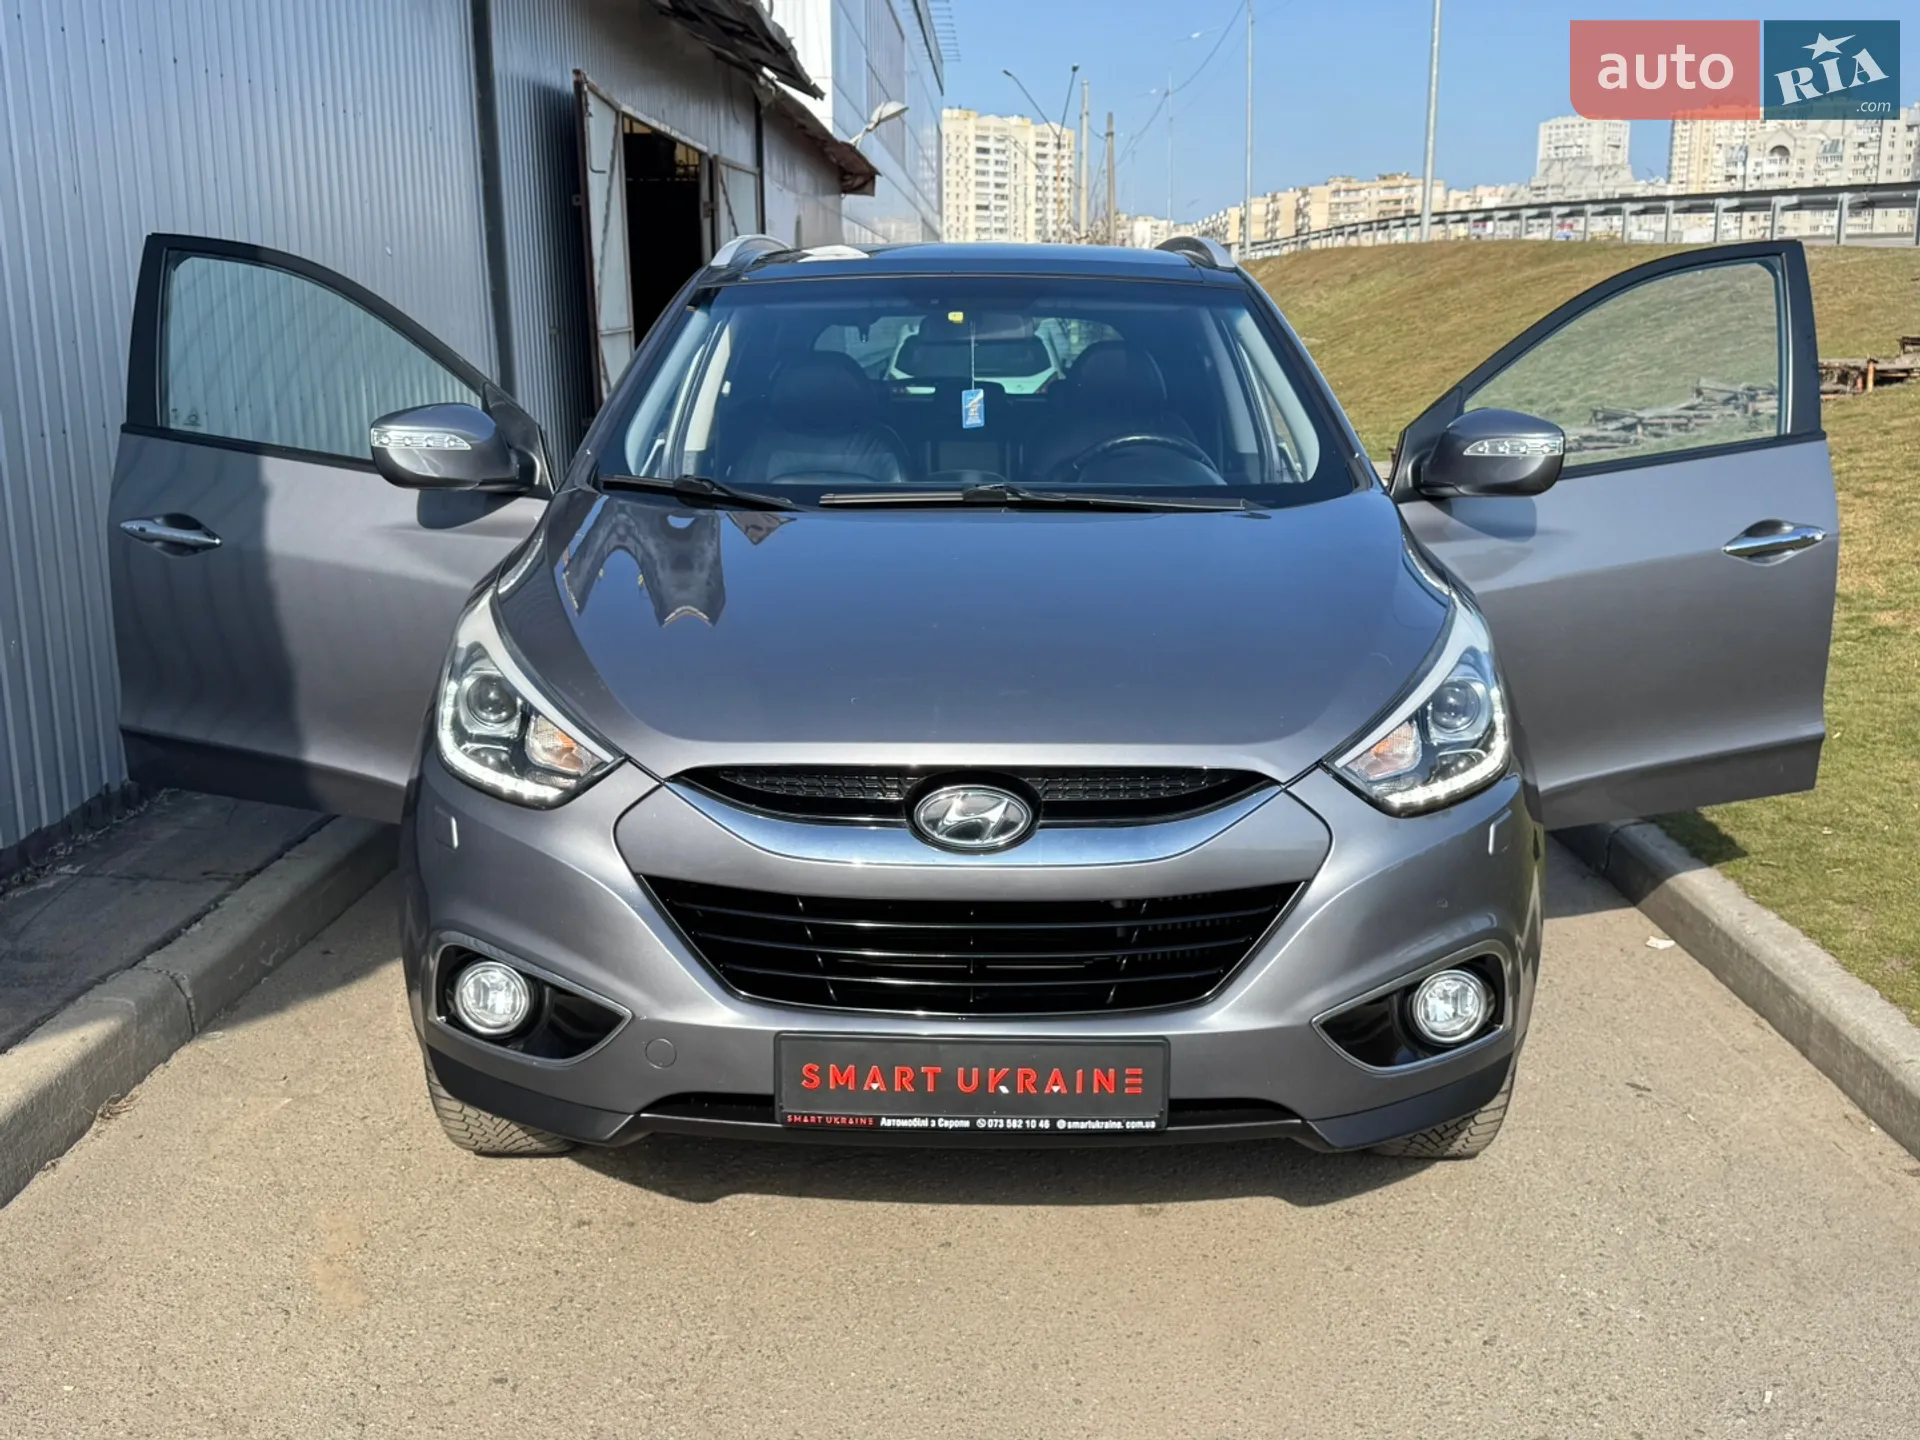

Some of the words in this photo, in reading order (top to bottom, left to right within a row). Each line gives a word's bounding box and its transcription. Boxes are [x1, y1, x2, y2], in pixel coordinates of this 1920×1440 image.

[801, 1063, 942, 1092] SMART
[957, 1067, 1144, 1095] UKRAINE
[787, 1114, 822, 1124] SMART
[825, 1116, 874, 1126] UKRAINE
[987, 1119, 1004, 1129] 073
[1025, 1120, 1036, 1129] 10
